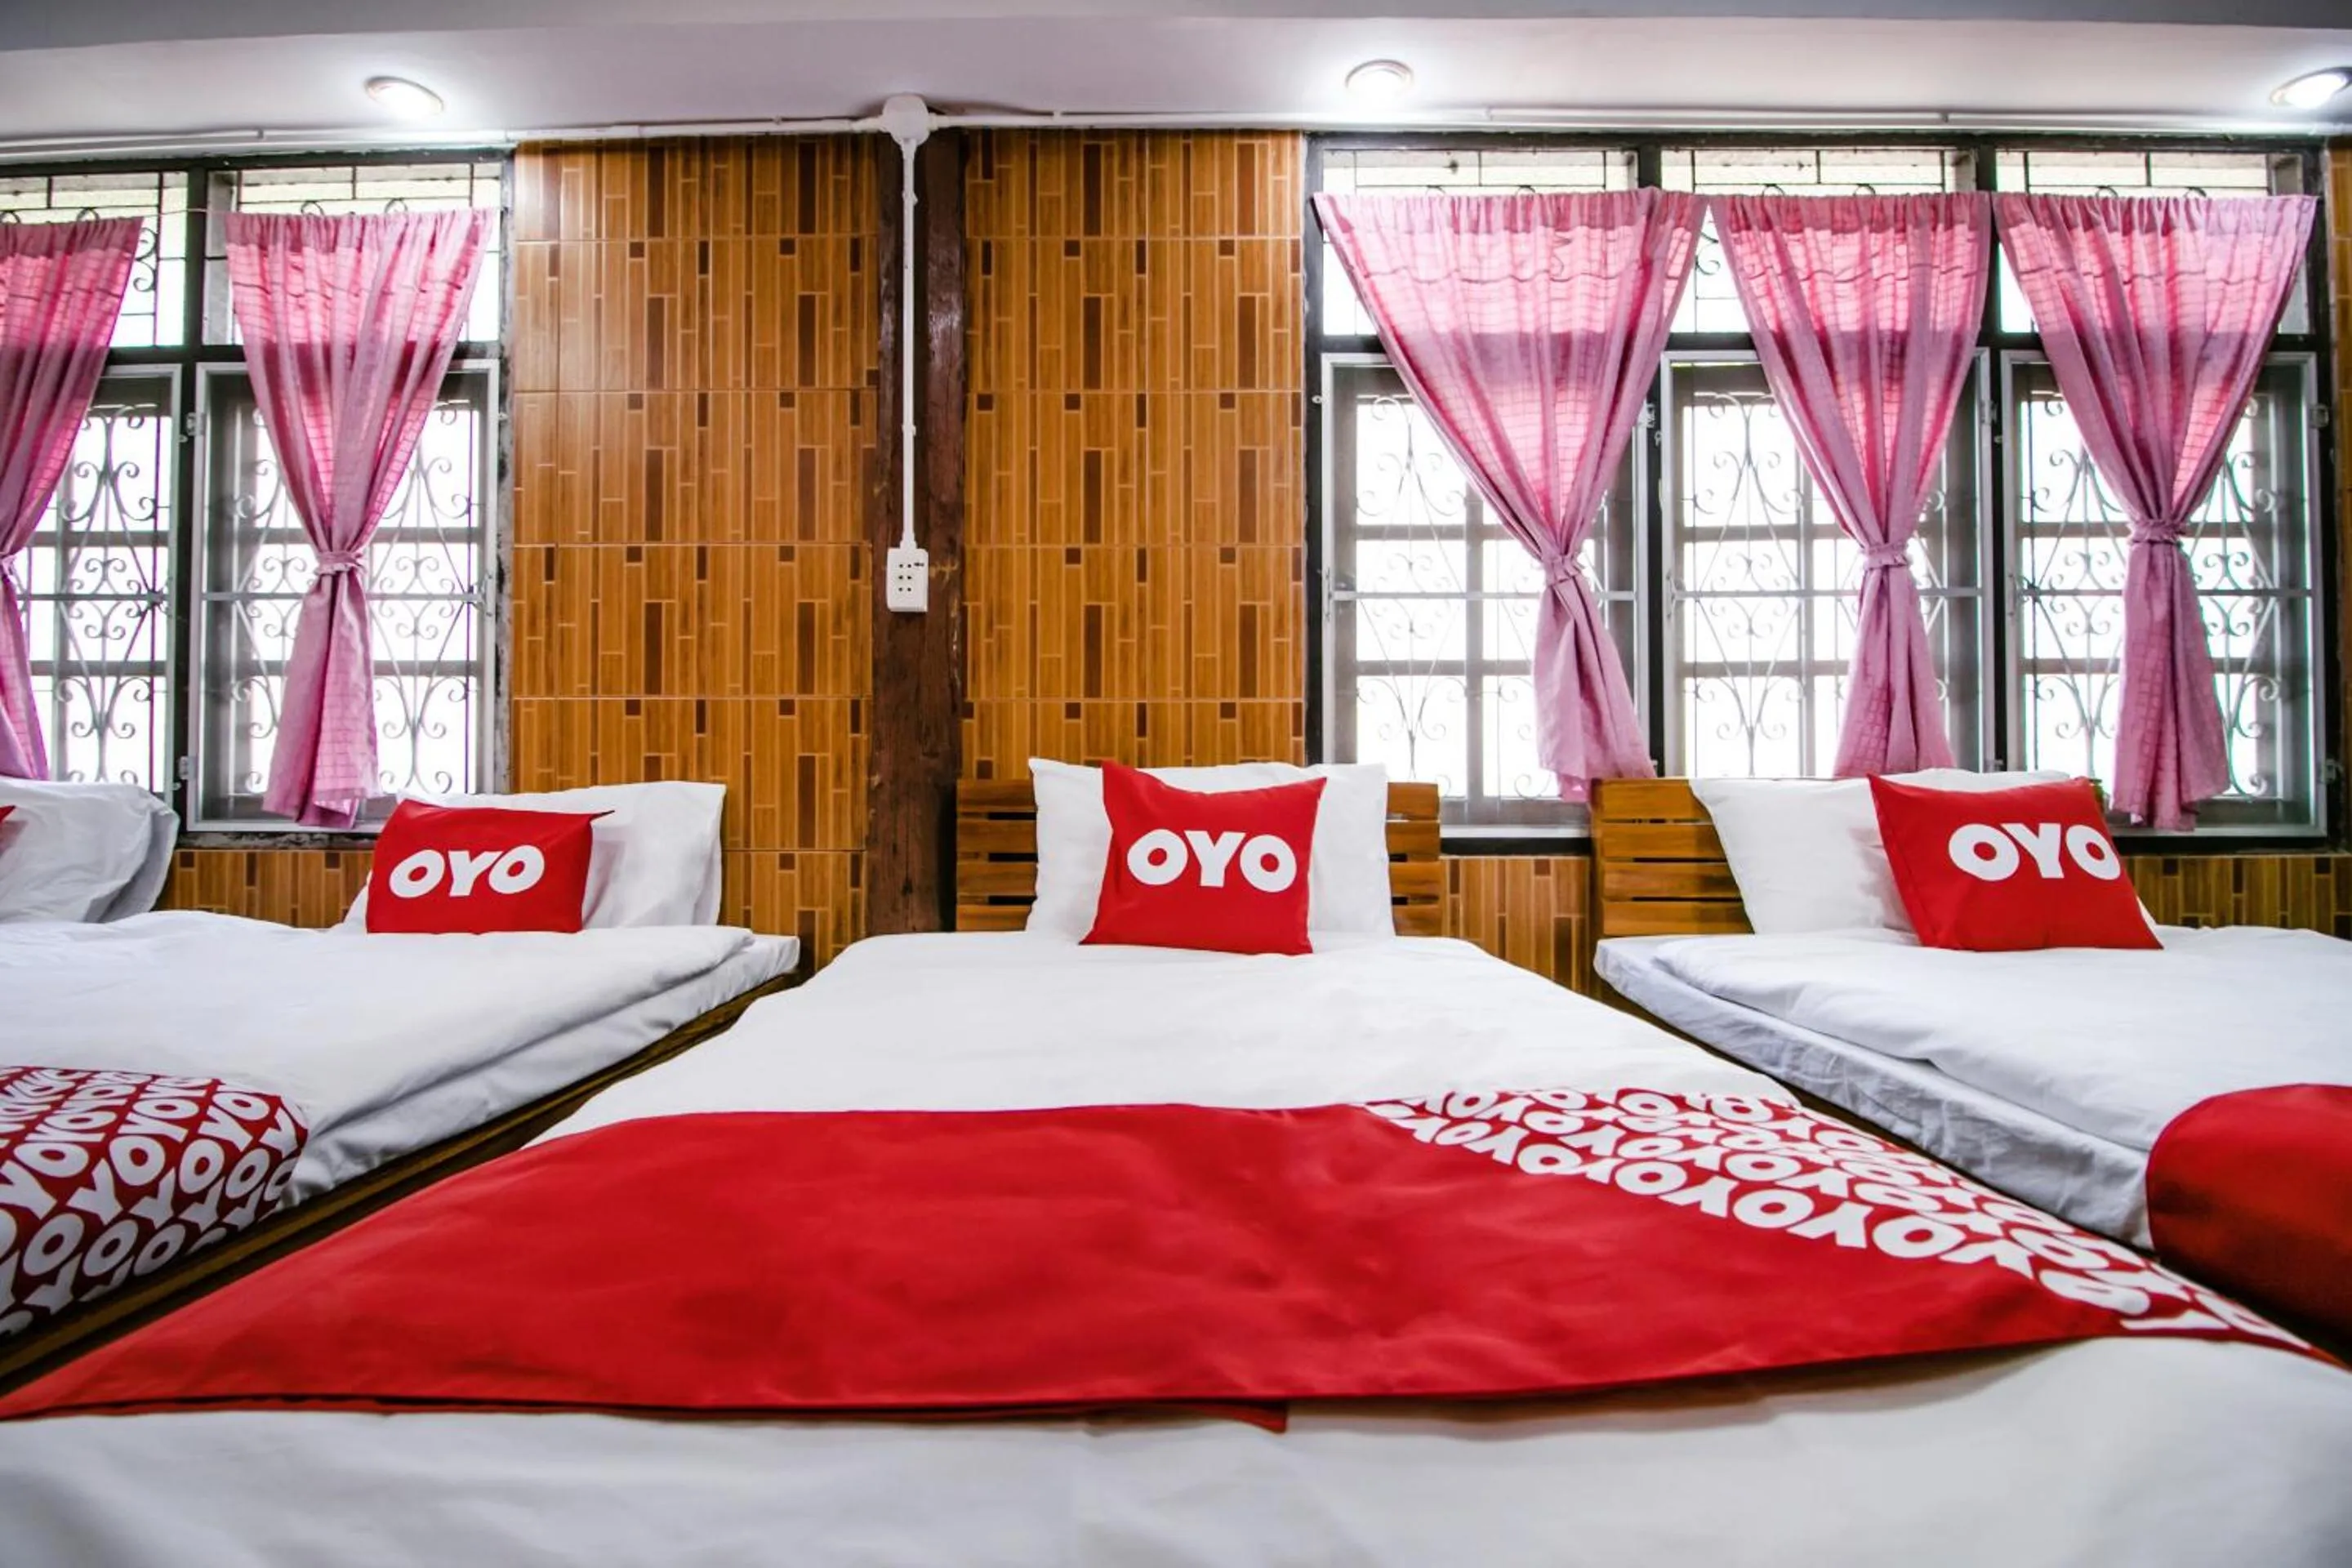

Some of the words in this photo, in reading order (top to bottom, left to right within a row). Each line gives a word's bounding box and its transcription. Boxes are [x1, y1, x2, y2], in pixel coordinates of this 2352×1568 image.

[390, 844, 545, 898] OYO
[1127, 828, 1297, 893] OYO
[1949, 822, 2120, 881] OYO
